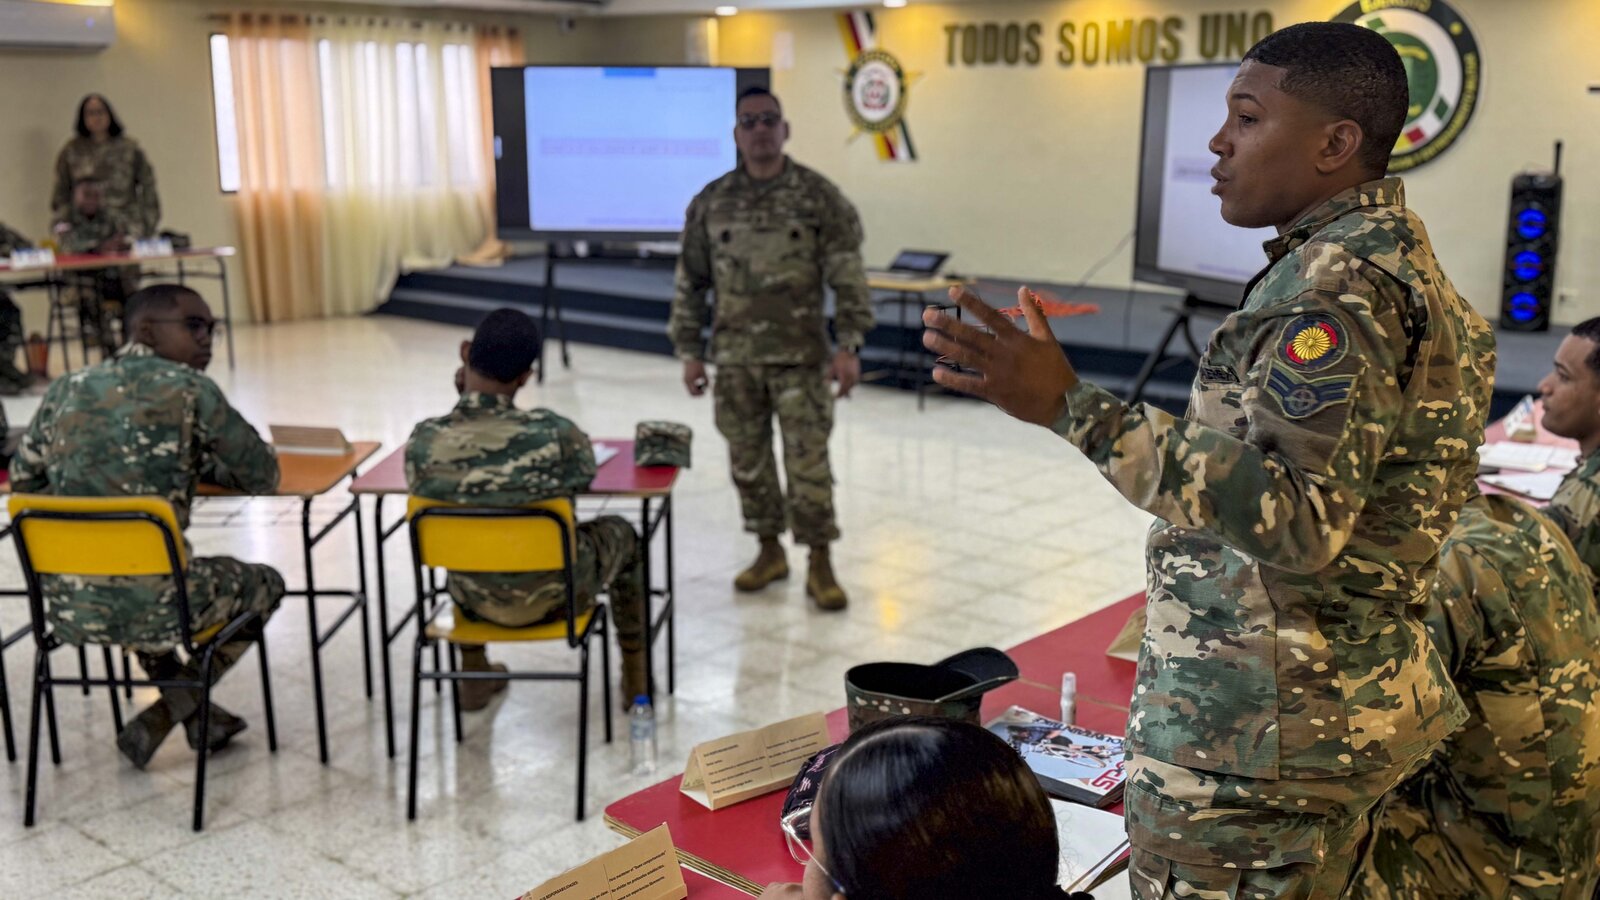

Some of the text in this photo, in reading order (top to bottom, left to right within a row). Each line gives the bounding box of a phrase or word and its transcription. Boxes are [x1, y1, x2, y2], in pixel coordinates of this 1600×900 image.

[944, 11, 1274, 66] TODOS SOMOS UNO
